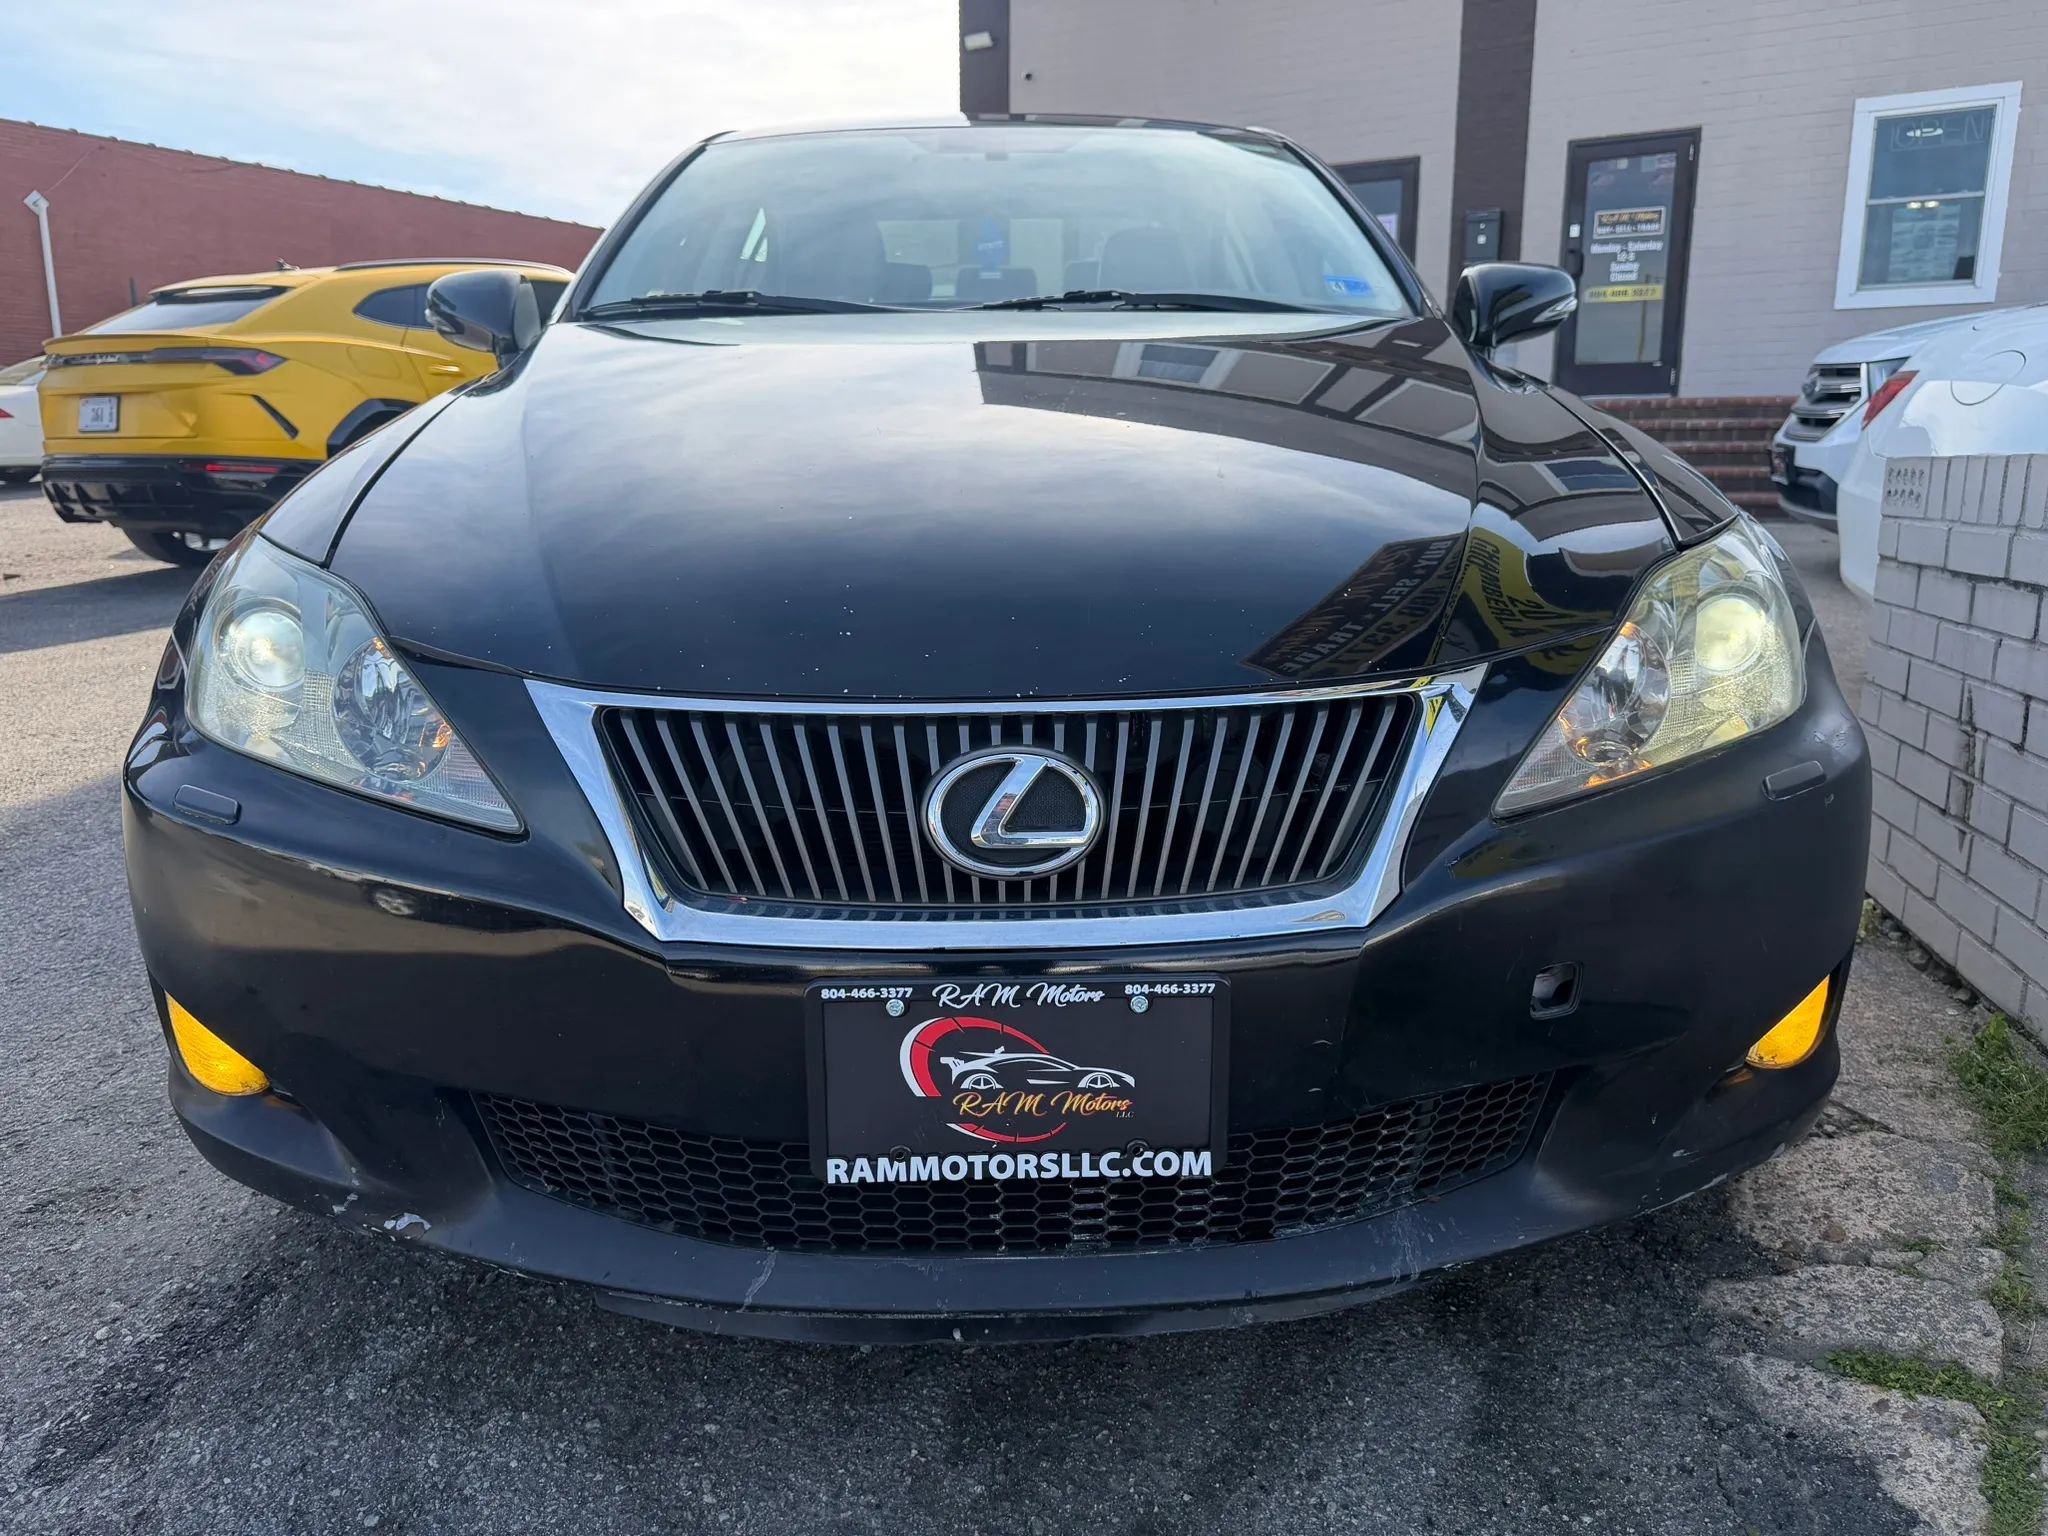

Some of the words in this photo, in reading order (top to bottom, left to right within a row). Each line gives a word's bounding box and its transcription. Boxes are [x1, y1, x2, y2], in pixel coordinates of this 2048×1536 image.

[820, 987, 913, 999] 804-466-3377
[932, 983, 1020, 1008] RAM
[1026, 982, 1105, 1007] Motors
[1124, 983, 1215, 995] 804-466-3377
[953, 1091, 1047, 1117] RAM
[1051, 1090, 1132, 1116] Motors
[826, 1151, 1212, 1184] RAMMOTORSLLC.COM
